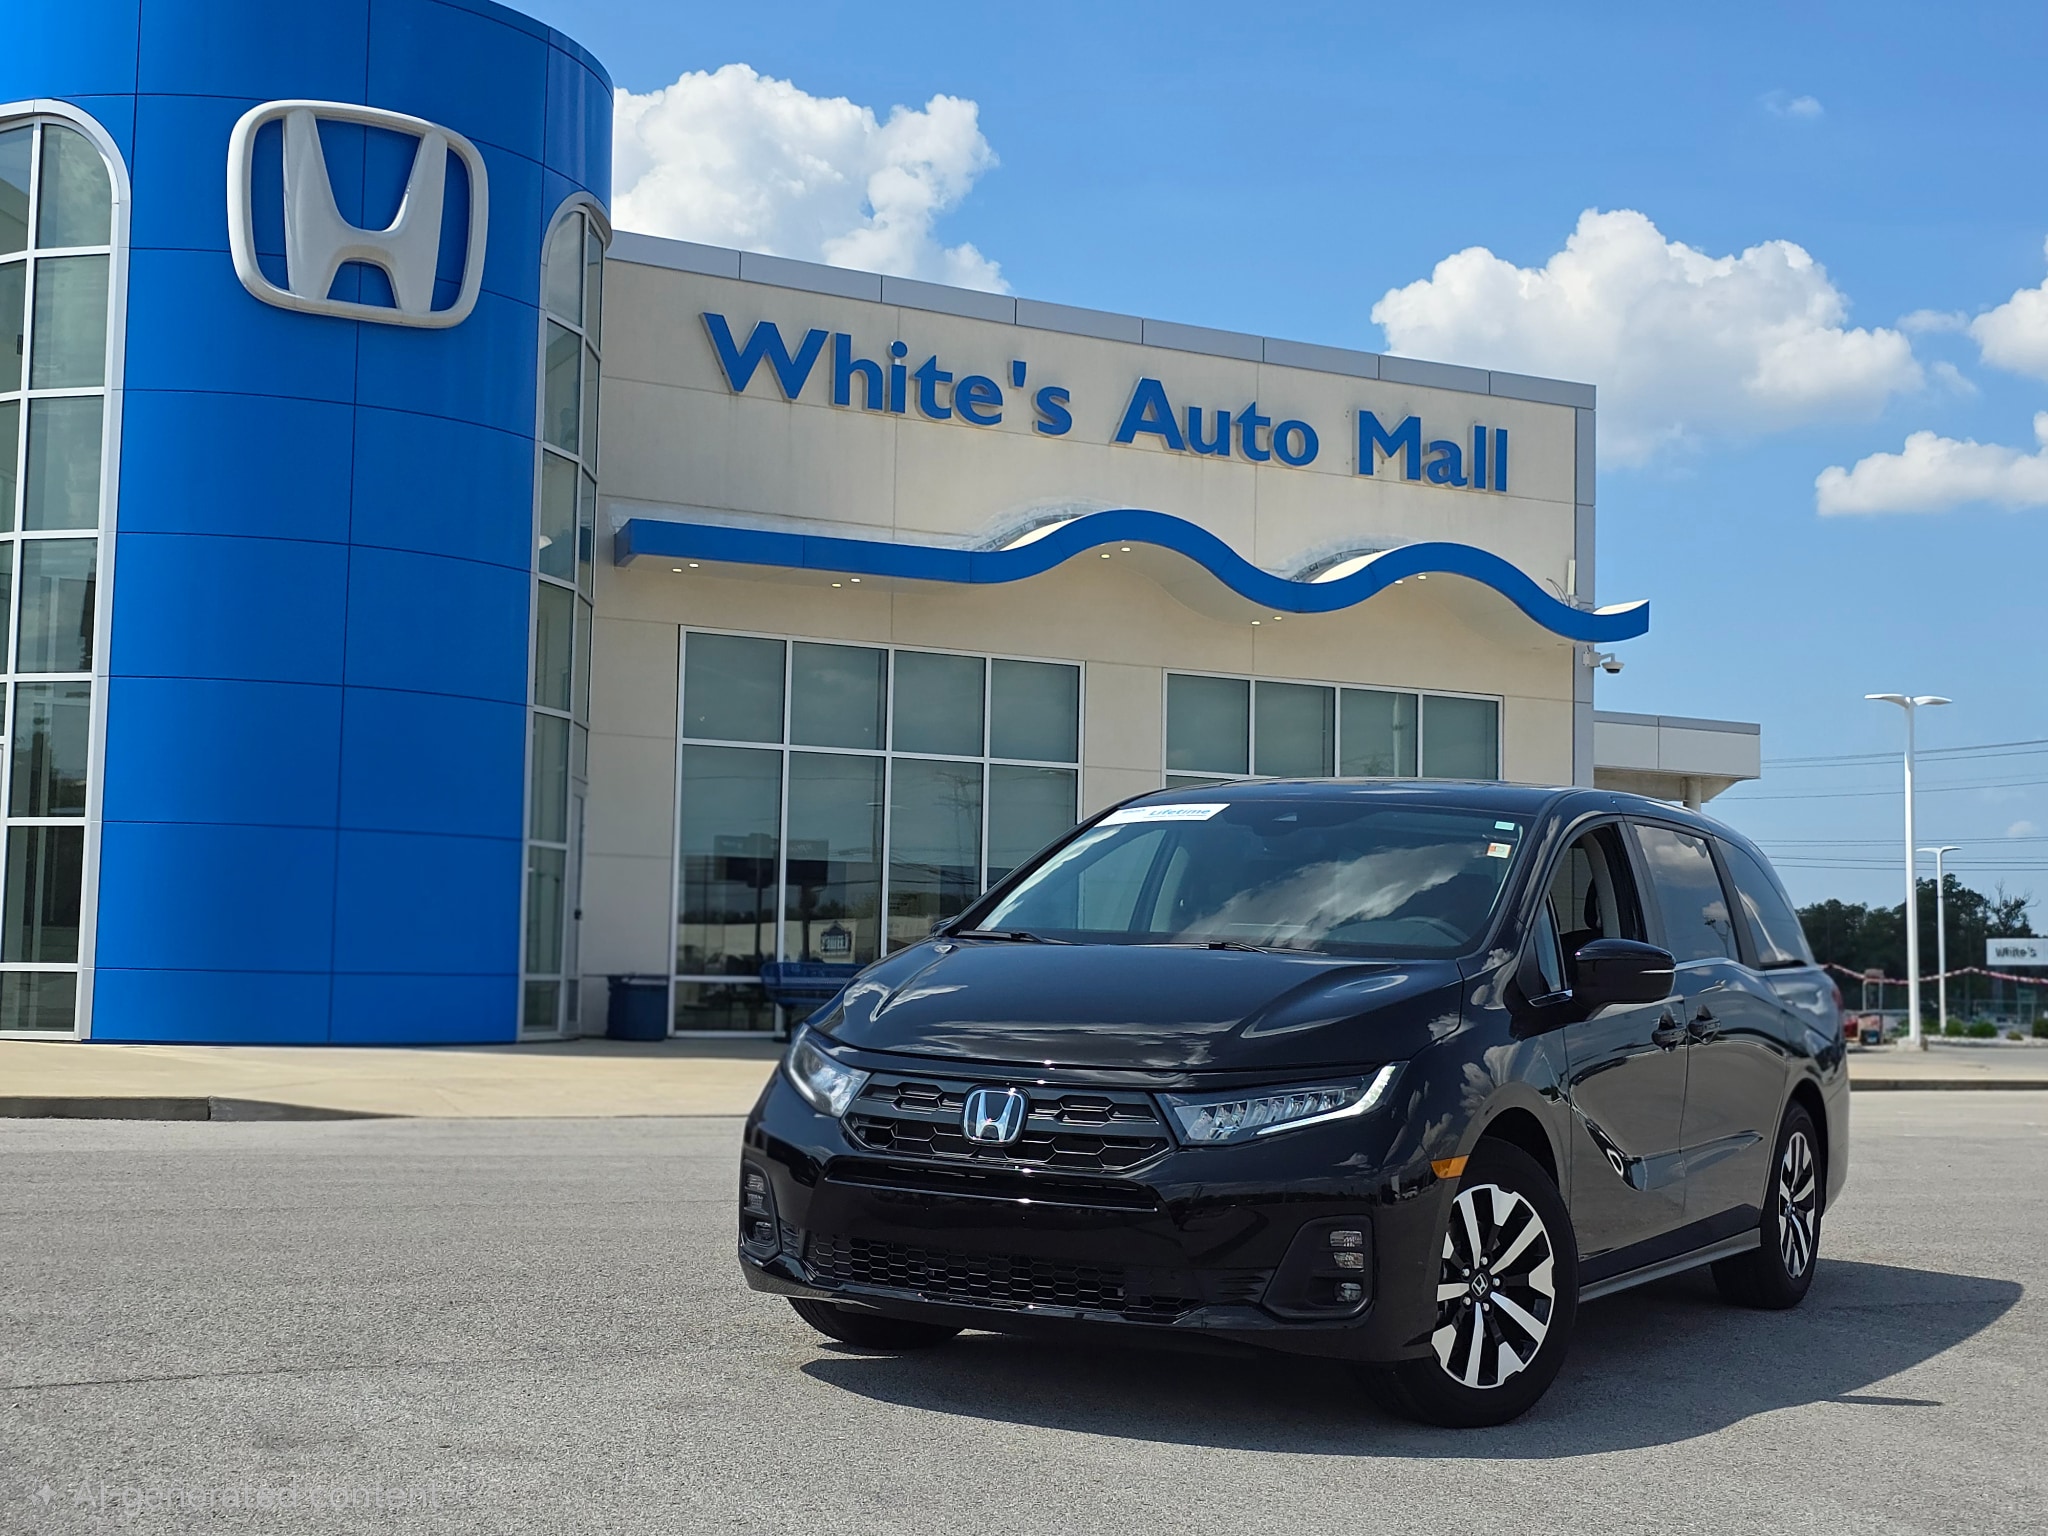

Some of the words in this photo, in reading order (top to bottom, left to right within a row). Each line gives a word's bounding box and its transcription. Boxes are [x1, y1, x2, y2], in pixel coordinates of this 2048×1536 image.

[701, 312, 1073, 436] White's
[1111, 376, 1320, 467] Auto
[1355, 409, 1509, 492] Mall
[1148, 807, 1212, 817] Lifetime
